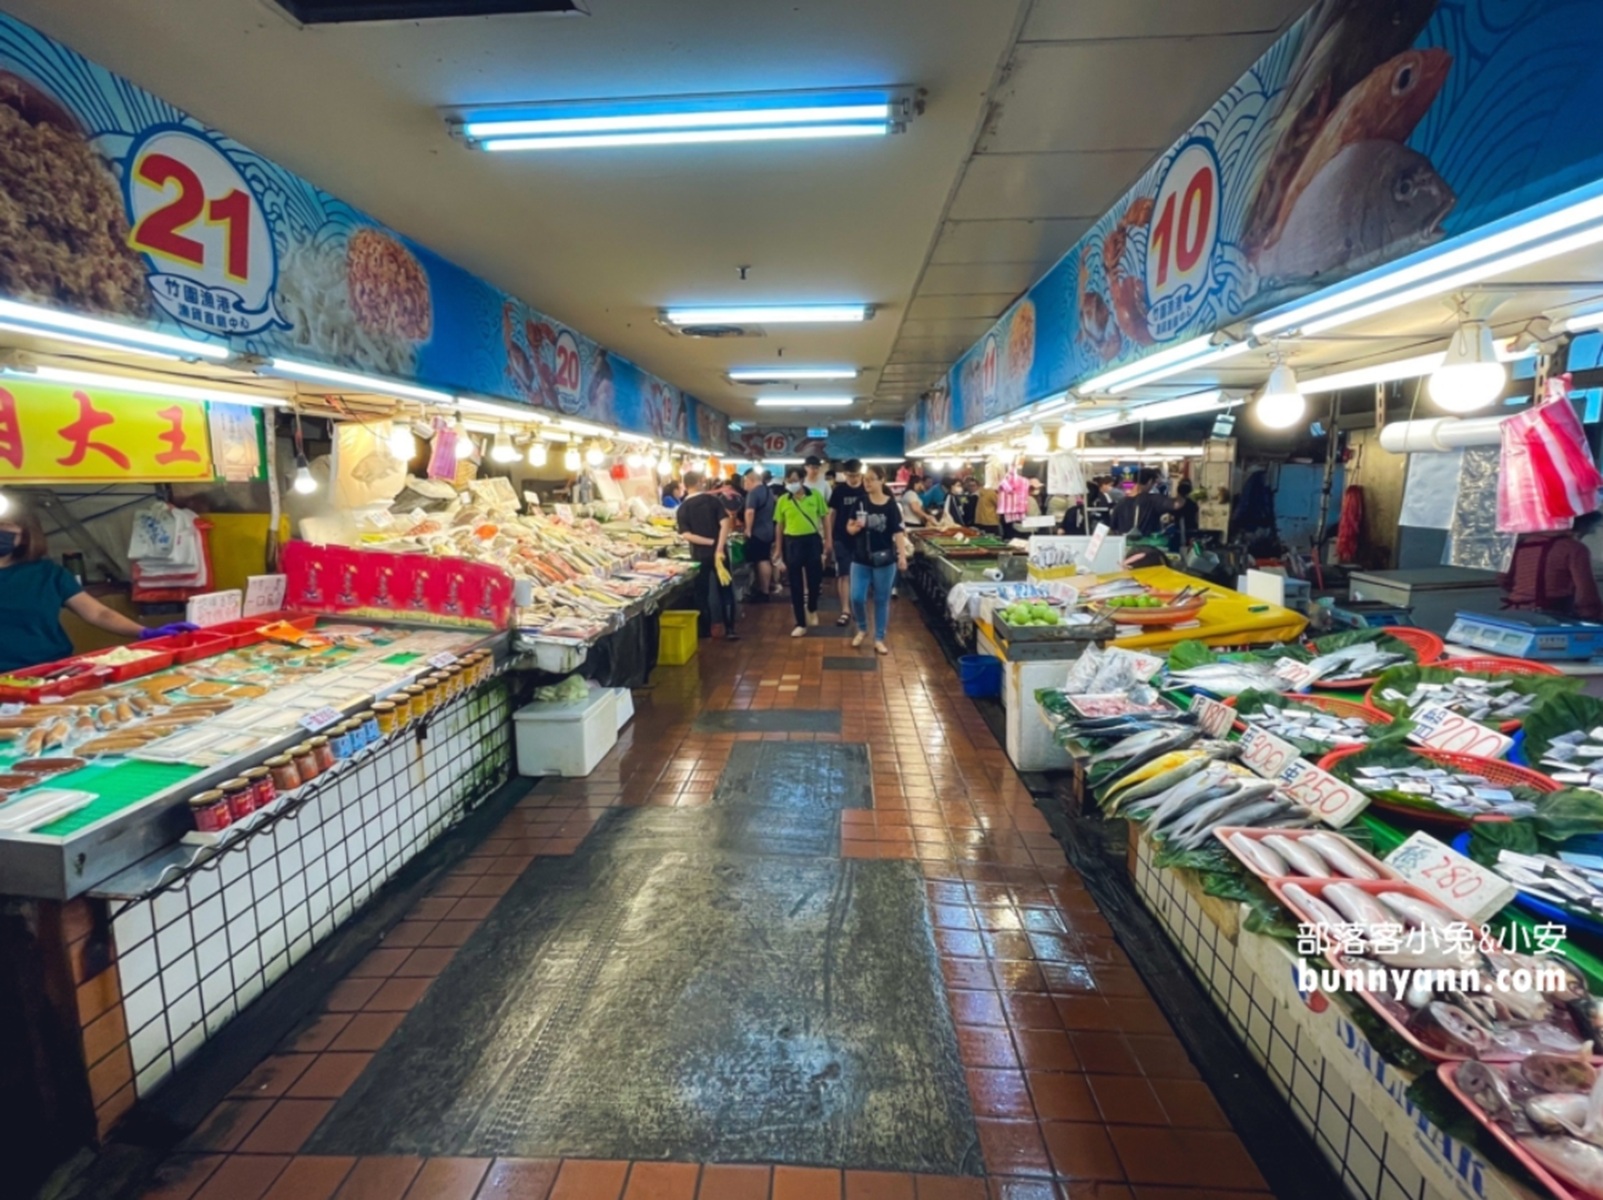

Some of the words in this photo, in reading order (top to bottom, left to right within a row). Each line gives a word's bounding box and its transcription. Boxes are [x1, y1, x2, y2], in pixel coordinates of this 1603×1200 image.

[130, 152, 250, 284] 21
[1152, 166, 1213, 288] 10
[556, 345, 579, 391] 20
[764, 436, 785, 451] 16
[1243, 733, 1286, 773] 300
[1281, 771, 1350, 815] 250
[1420, 854, 1484, 899] 280
